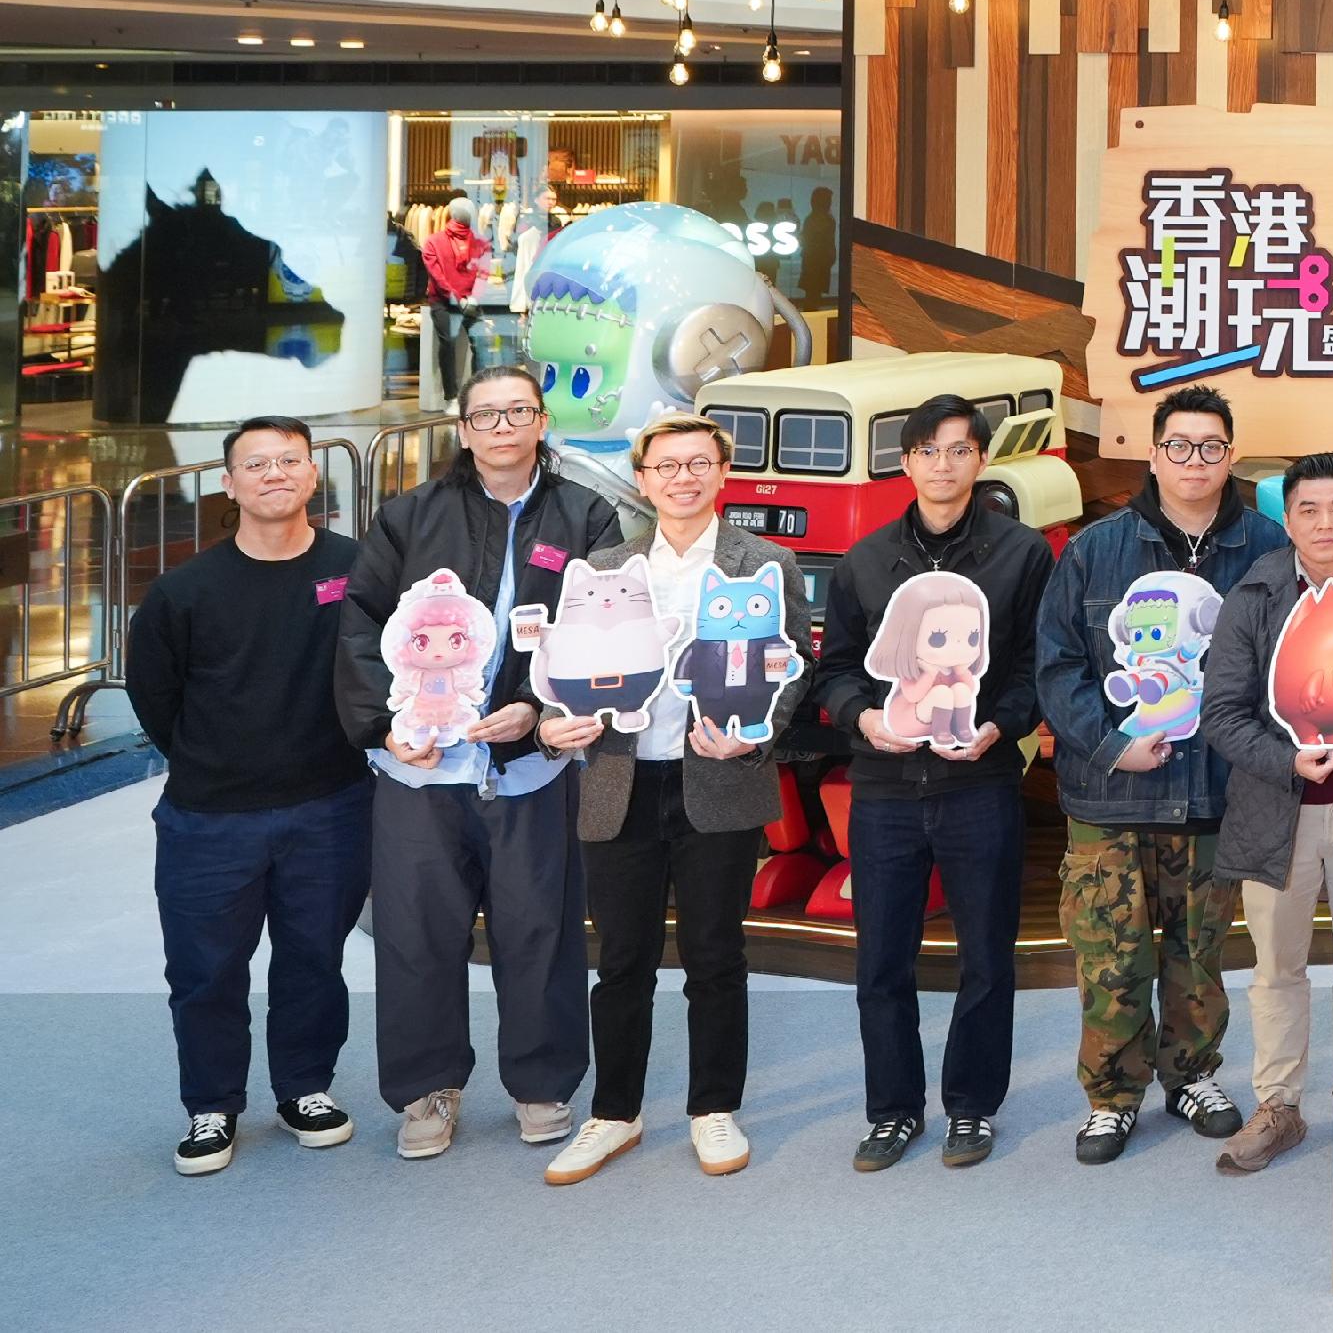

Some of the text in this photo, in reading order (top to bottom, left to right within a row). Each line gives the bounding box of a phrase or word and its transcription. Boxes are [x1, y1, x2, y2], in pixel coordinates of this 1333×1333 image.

[1147, 174, 1309, 273] 香港
[1124, 255, 1323, 372] 潮玩
[779, 510, 795, 533] 70
